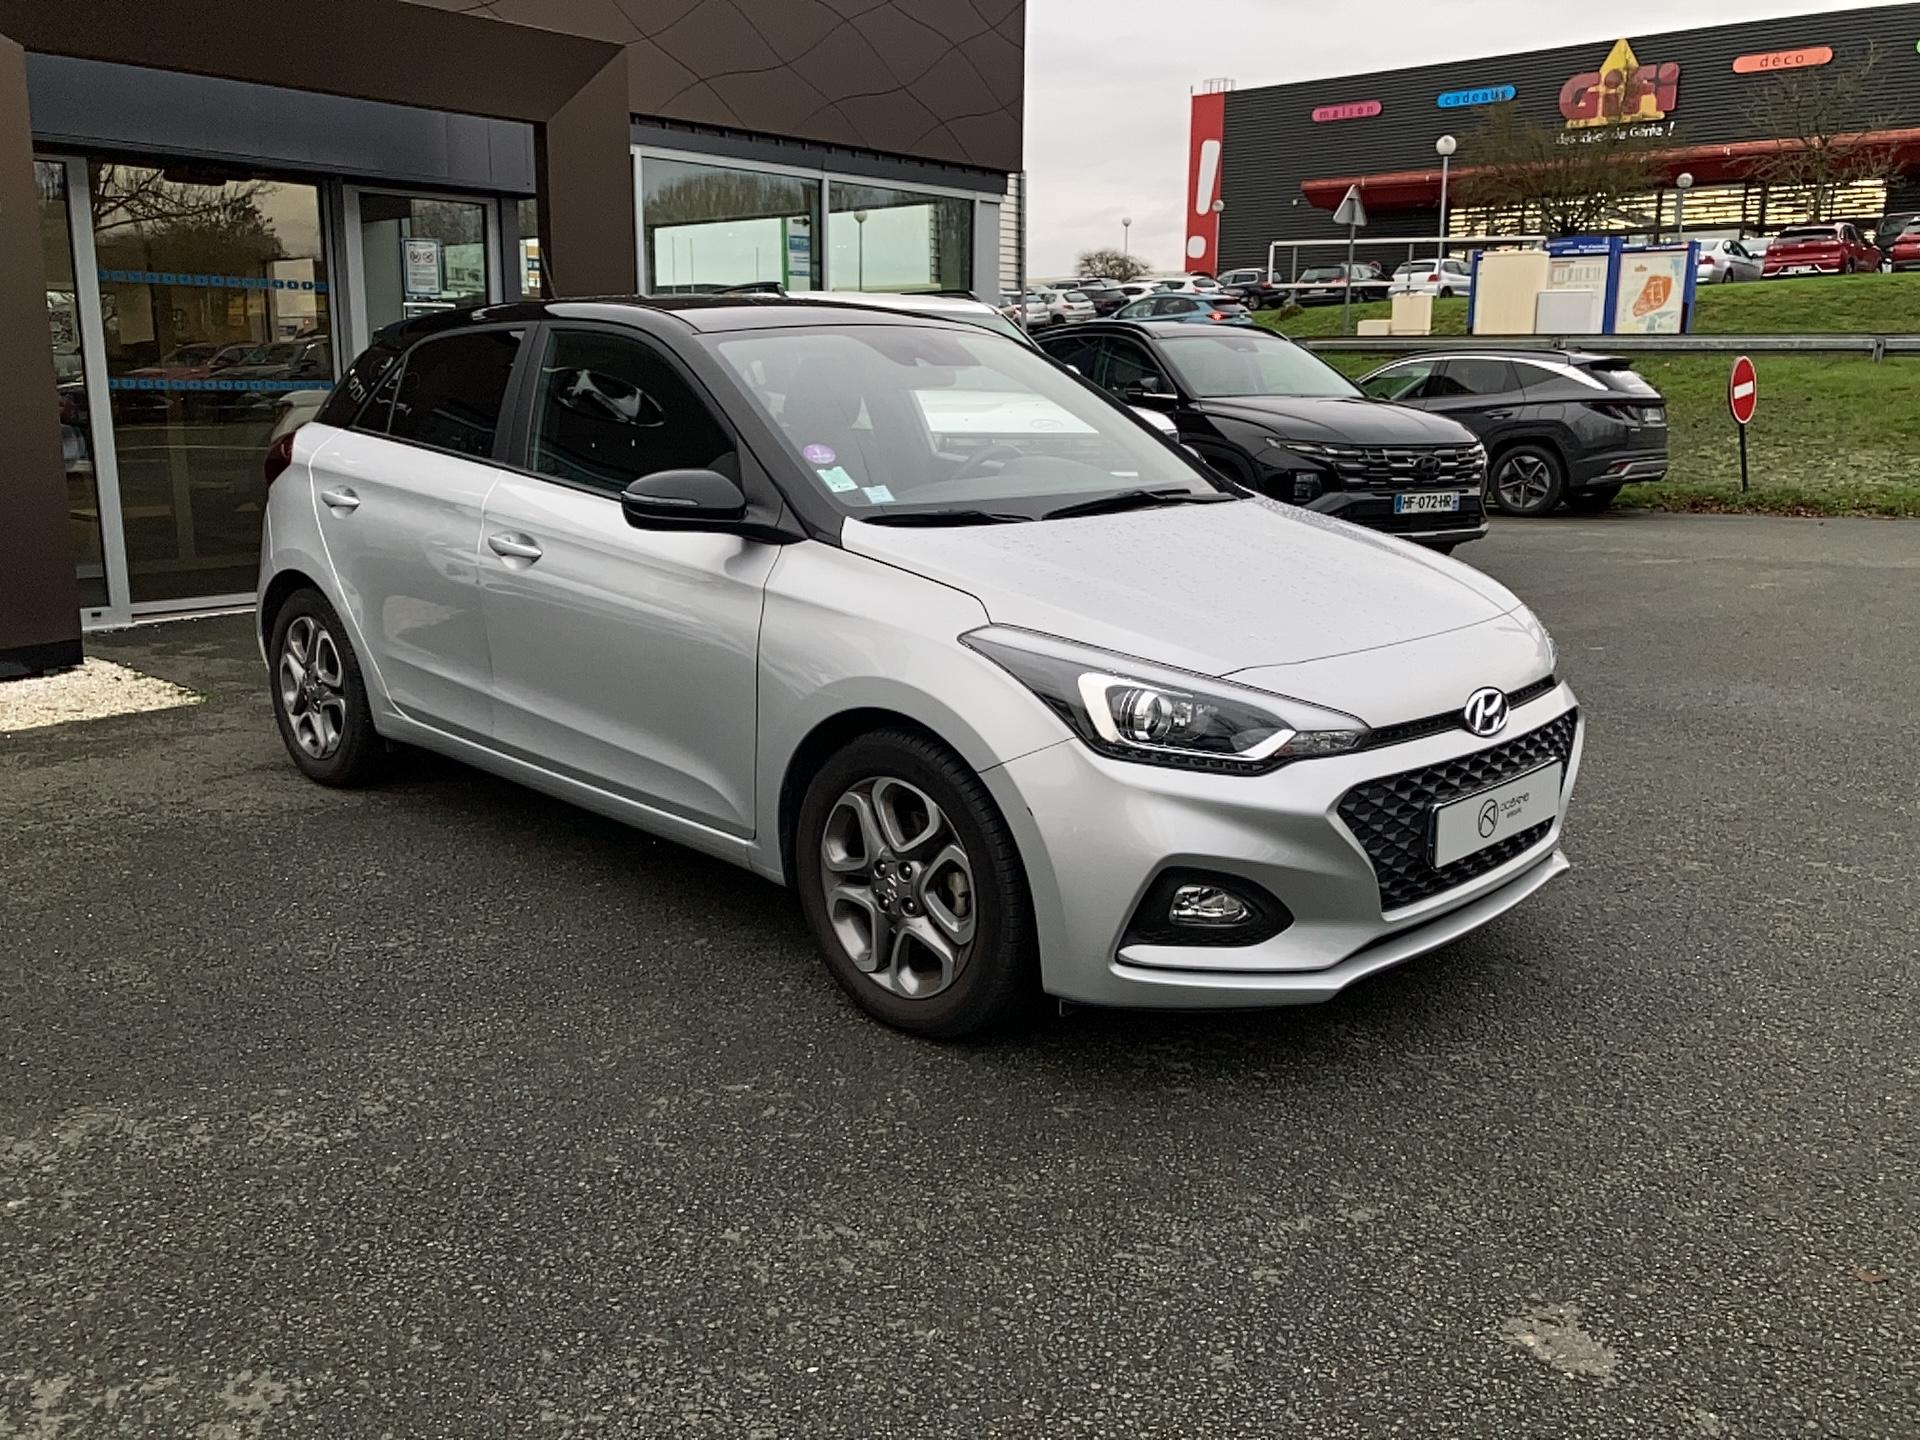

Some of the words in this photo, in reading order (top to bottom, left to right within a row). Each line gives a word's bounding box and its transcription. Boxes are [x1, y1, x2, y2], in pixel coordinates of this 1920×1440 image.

[1759, 53, 1805, 69] déco
[1444, 90, 1508, 107] cadeaux
[1318, 104, 1374, 119] maison
[1402, 494, 1452, 510] HF-072-HR
